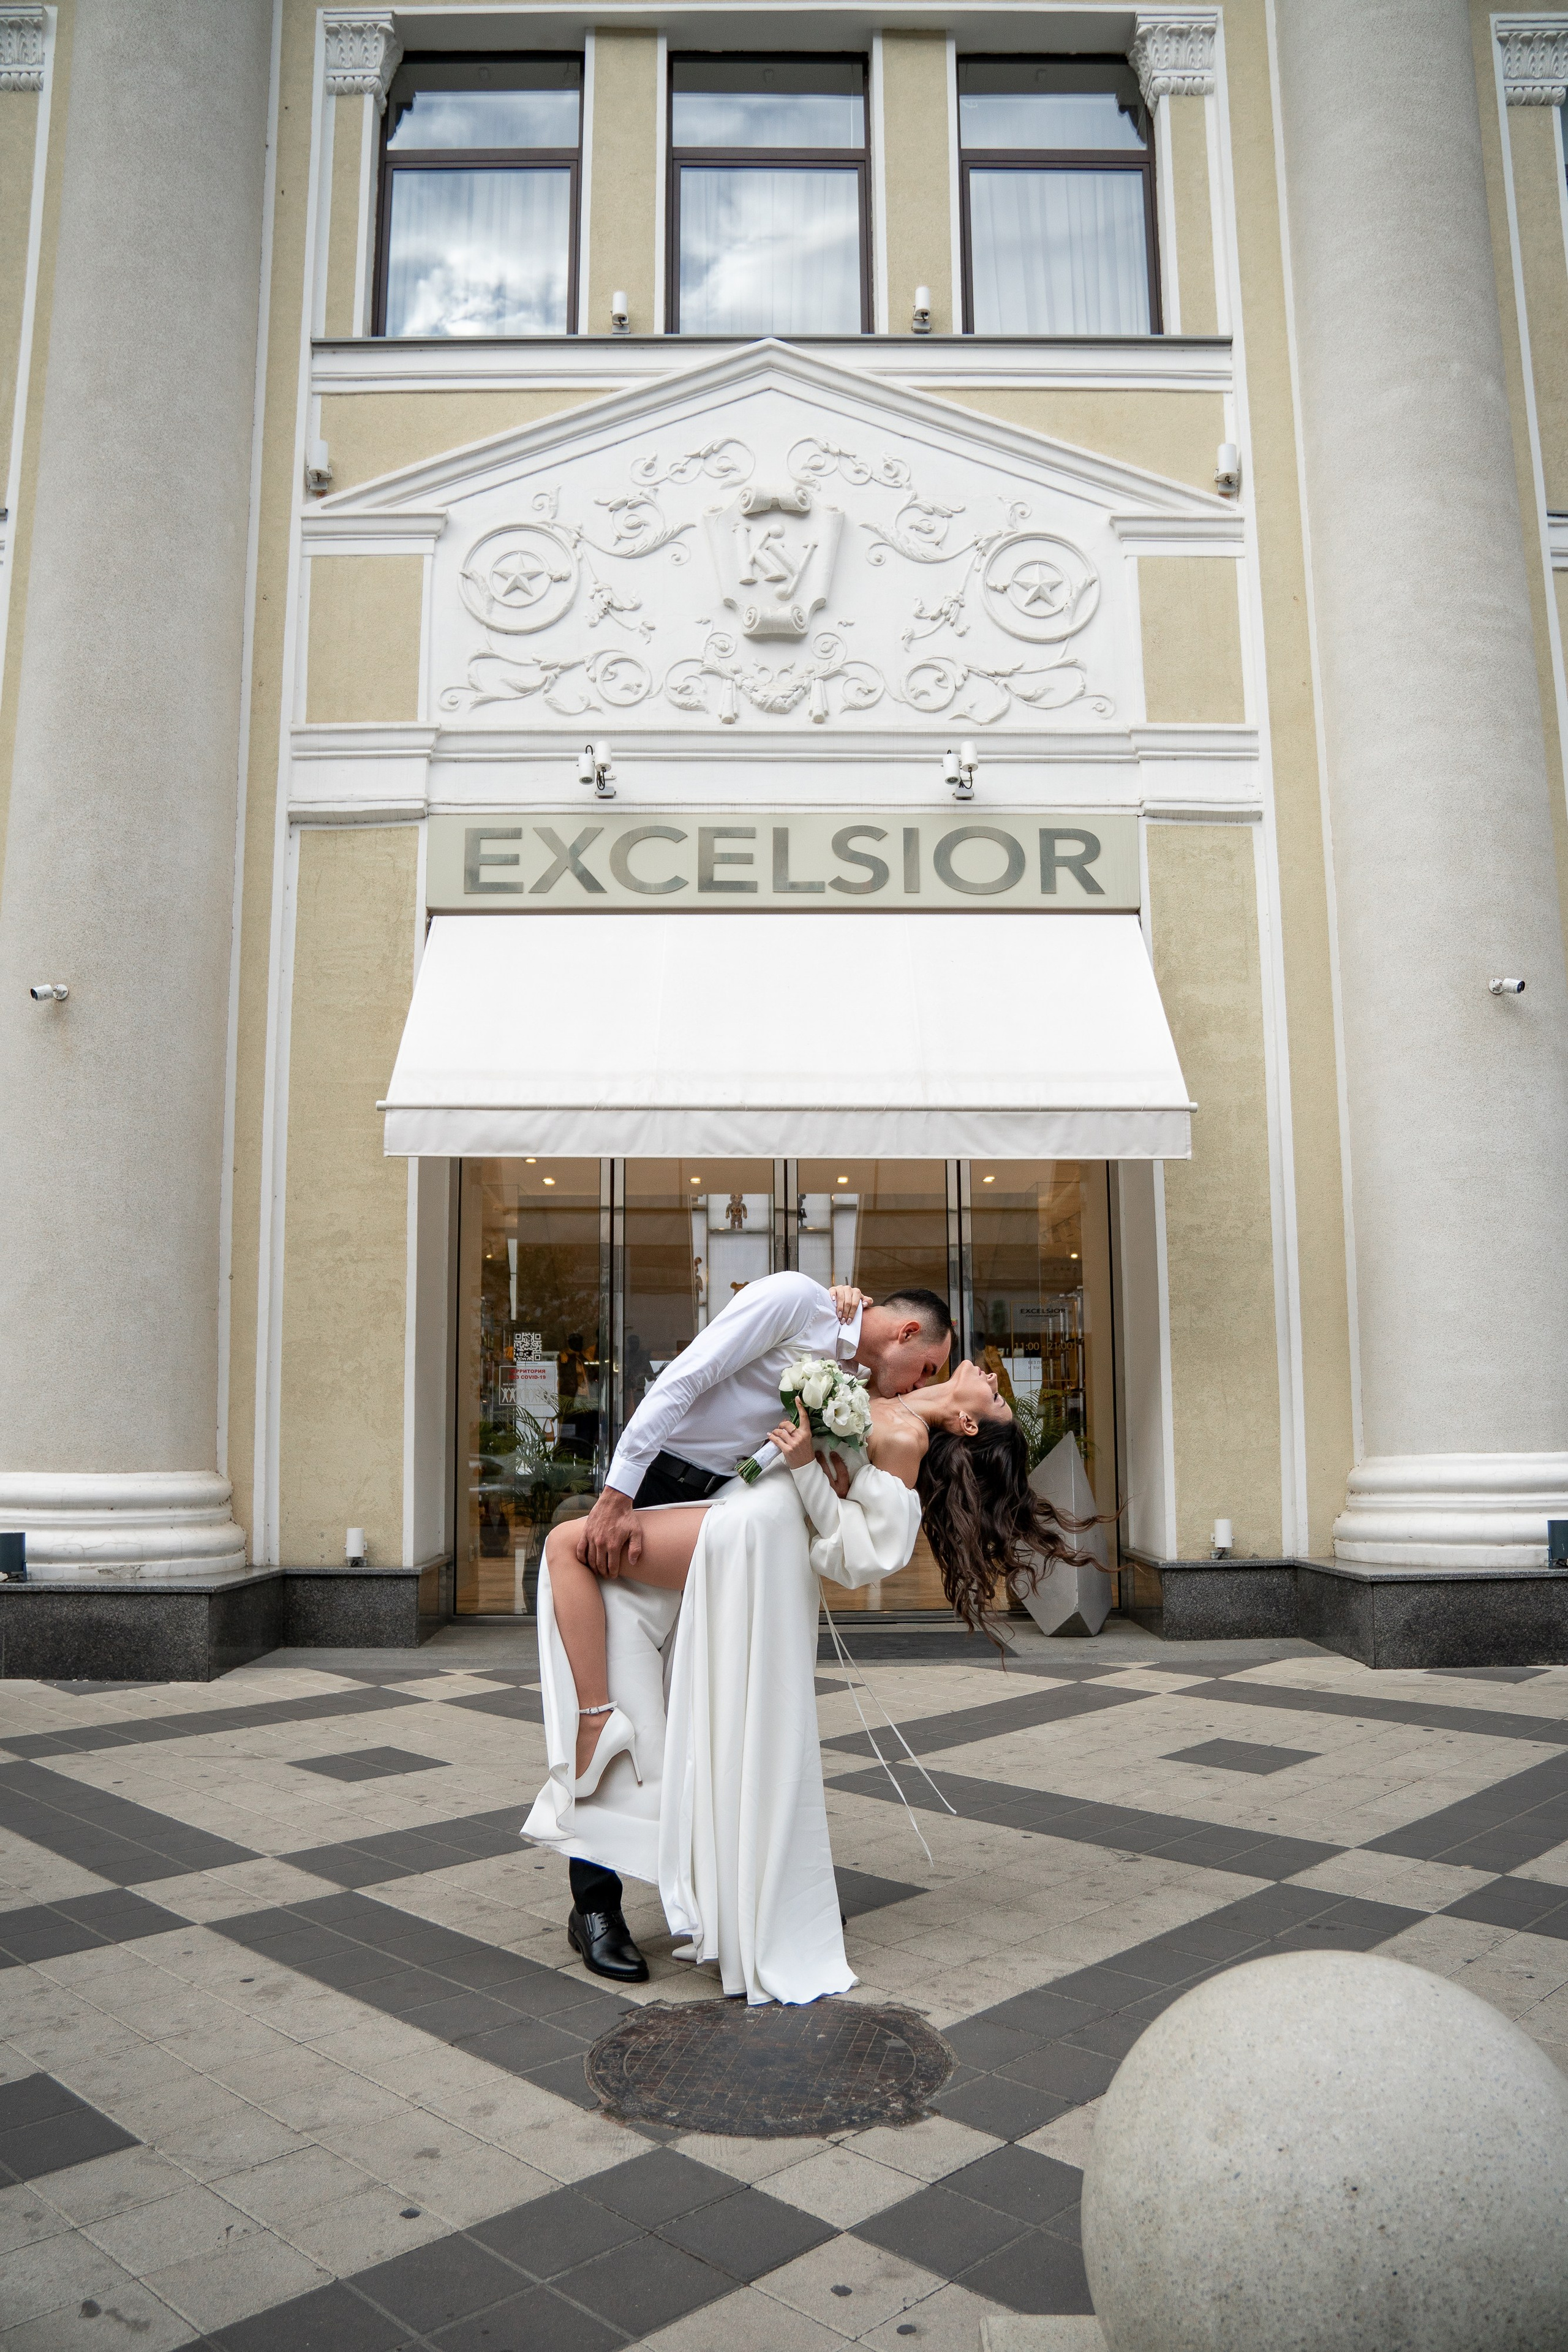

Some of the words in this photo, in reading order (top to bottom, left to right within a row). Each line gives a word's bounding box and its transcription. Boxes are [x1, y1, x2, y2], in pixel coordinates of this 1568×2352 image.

[463, 825, 1106, 895] EXCELSIOR
[1014, 1342, 1039, 1351] 11:00
[1047, 1341, 1073, 1350] 21:00
